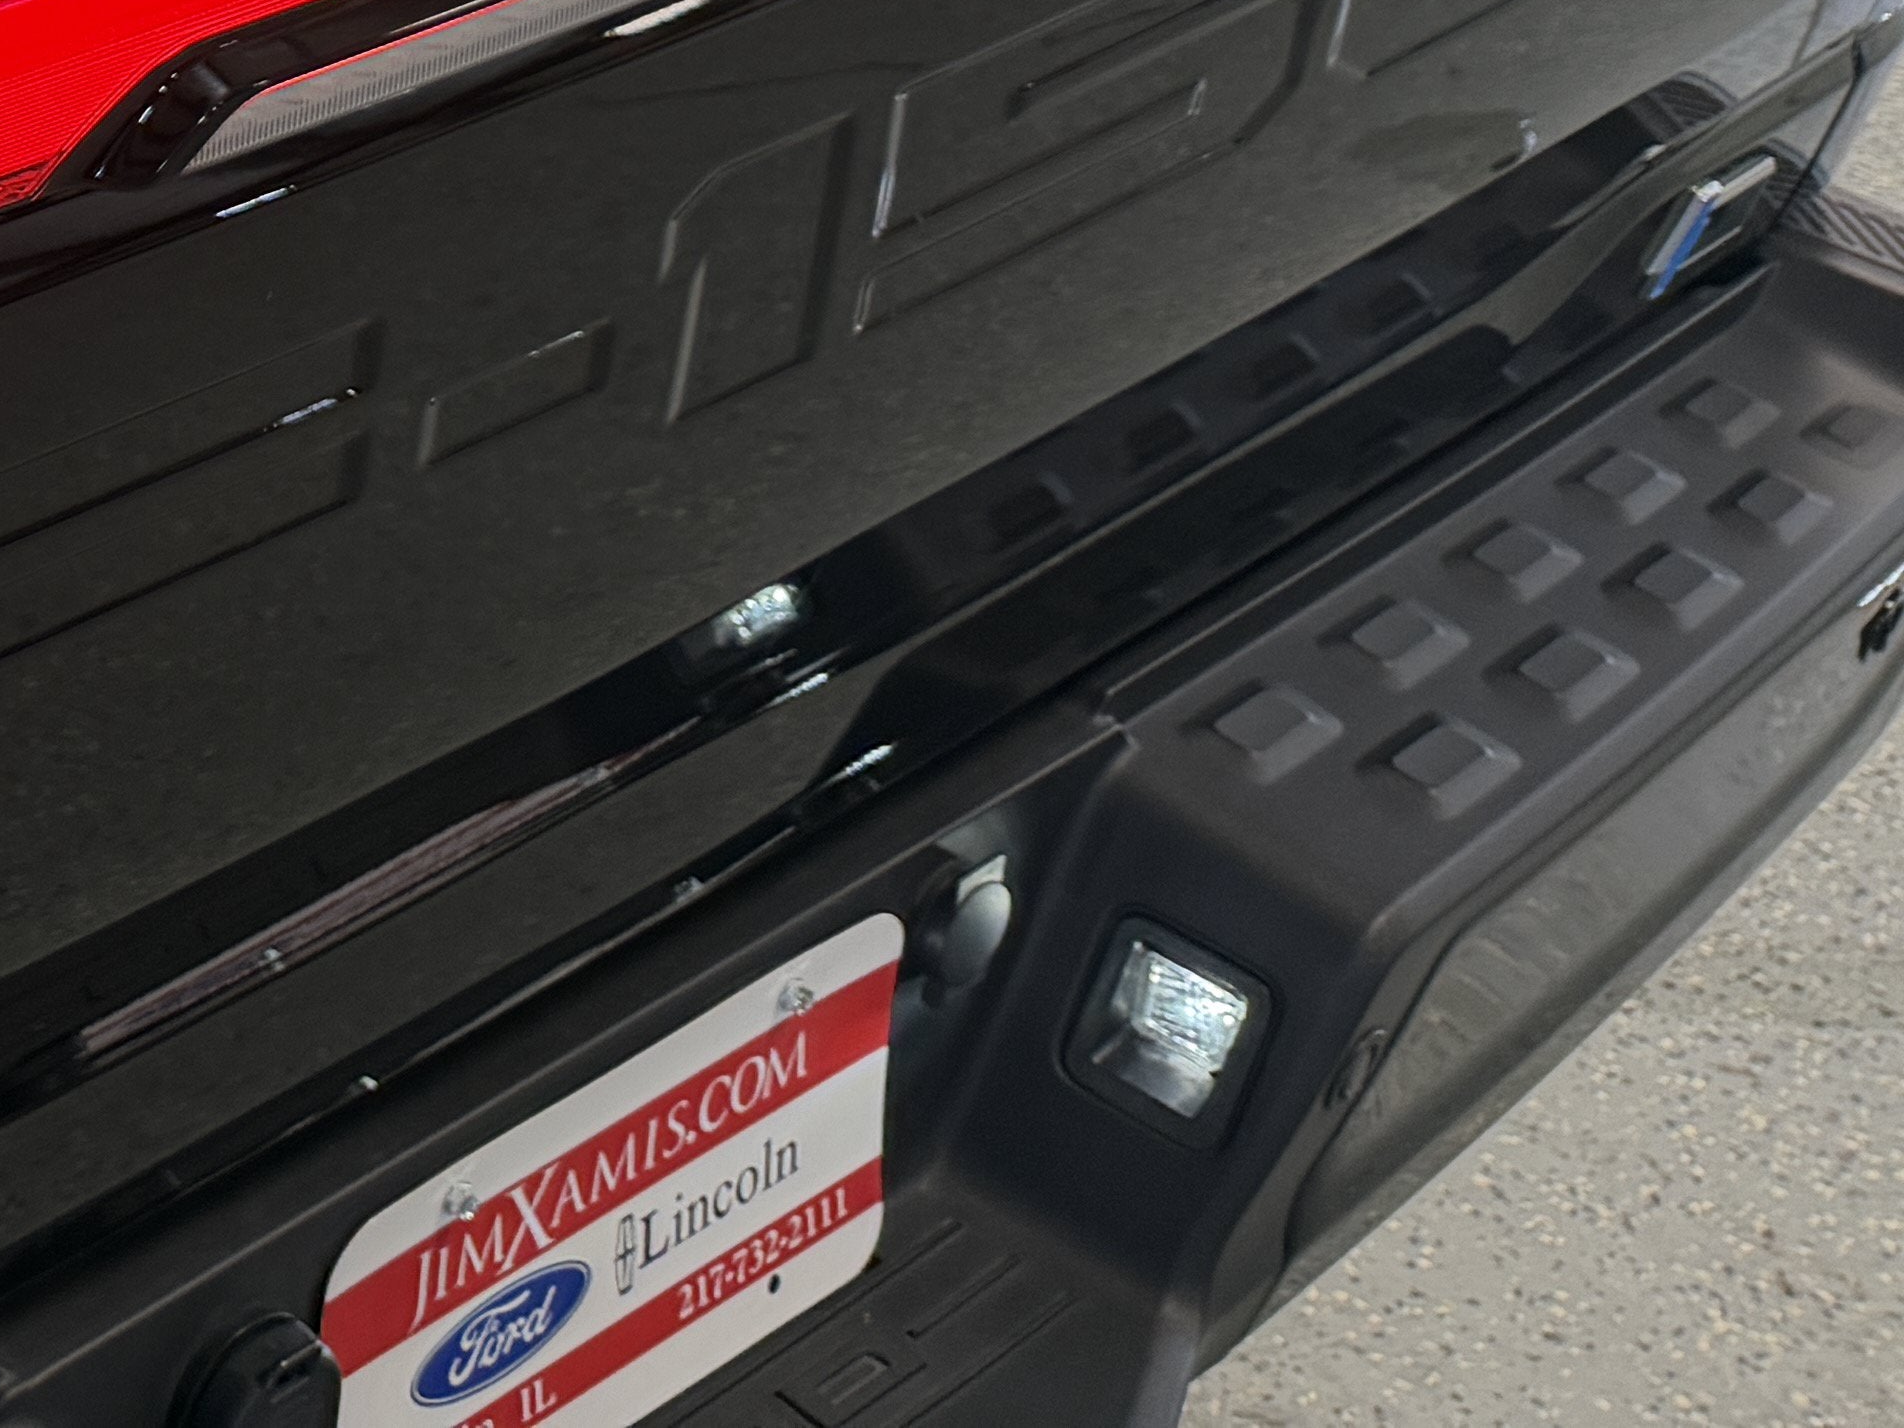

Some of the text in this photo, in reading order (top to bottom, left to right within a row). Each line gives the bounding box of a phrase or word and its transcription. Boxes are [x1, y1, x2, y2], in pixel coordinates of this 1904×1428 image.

[406, 1032, 810, 1337] JIMXAMIS.COM
[636, 1137, 801, 1269] Lincoln
[675, 1189, 851, 1322] 217-732-2111
[448, 1287, 555, 1387] Ford
[520, 1378, 559, 1423] IL
